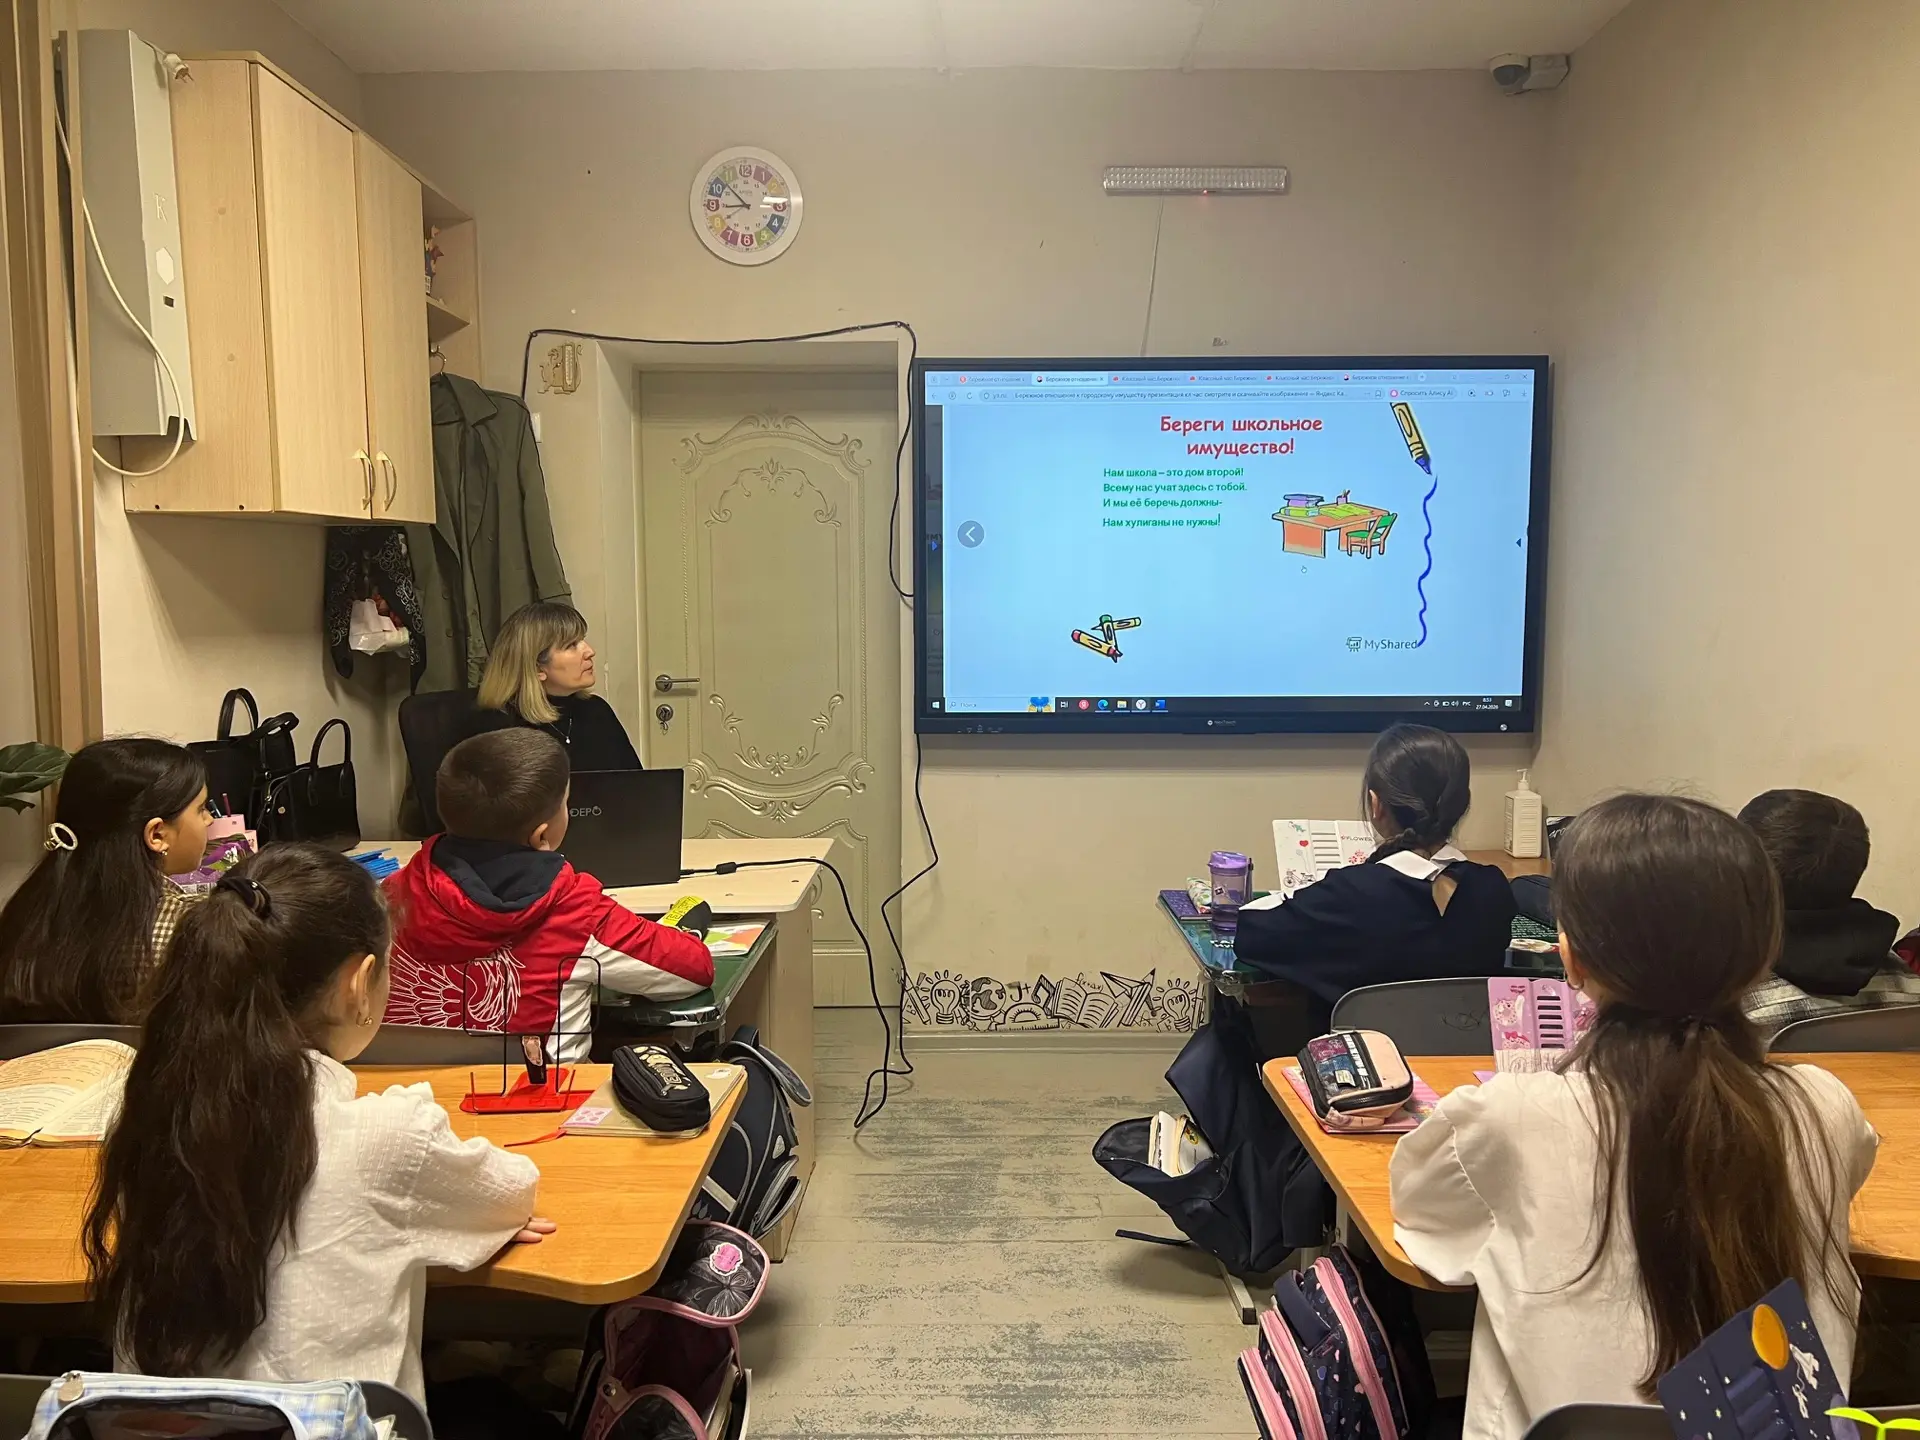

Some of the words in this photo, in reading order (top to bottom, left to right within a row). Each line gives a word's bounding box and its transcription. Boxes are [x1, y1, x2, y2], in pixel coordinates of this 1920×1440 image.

[741, 164, 751, 176] 12
[725, 170, 733, 182] 11
[712, 183, 723, 194] 10
[771, 183, 778, 192] 2
[709, 200, 715, 210] 9
[714, 217, 721, 228] 8
[772, 218, 779, 228] 4
[726, 230, 733, 240] 7
[743, 235, 751, 246] 6
[760, 230, 768, 240] 5
[1400, 389, 1428, 398] Спросить
[1160, 416, 1225, 436] Береги
[1232, 417, 1323, 432] школьное
[1187, 438, 1295, 459] имущество!
[1103, 468, 1124, 478] Нам
[1126, 468, 1158, 477] школа
[1166, 468, 1183, 477] это
[1185, 469, 1205, 478] дом
[1206, 467, 1244, 477] второй!
[1103, 483, 1134, 494] Всему
[1135, 484, 1153, 493] нас
[1154, 484, 1177, 494] учат
[1178, 483, 1207, 493] здесь
[1215, 481, 1248, 492] тобой.
[1103, 498, 1111, 508] И
[1112, 500, 1129, 508] мы
[1129, 498, 1142, 508] её
[1143, 498, 1179, 509] беречь
[1180, 498, 1223, 509] должны-
[1102, 518, 1123, 528] Нам
[1125, 518, 1171, 529] хулиганы
[1172, 518, 1185, 527] не
[1186, 513, 1221, 528] нужны!
[1364, 638, 1418, 652] MyShared
[569, 805, 602, 817] DEPO
